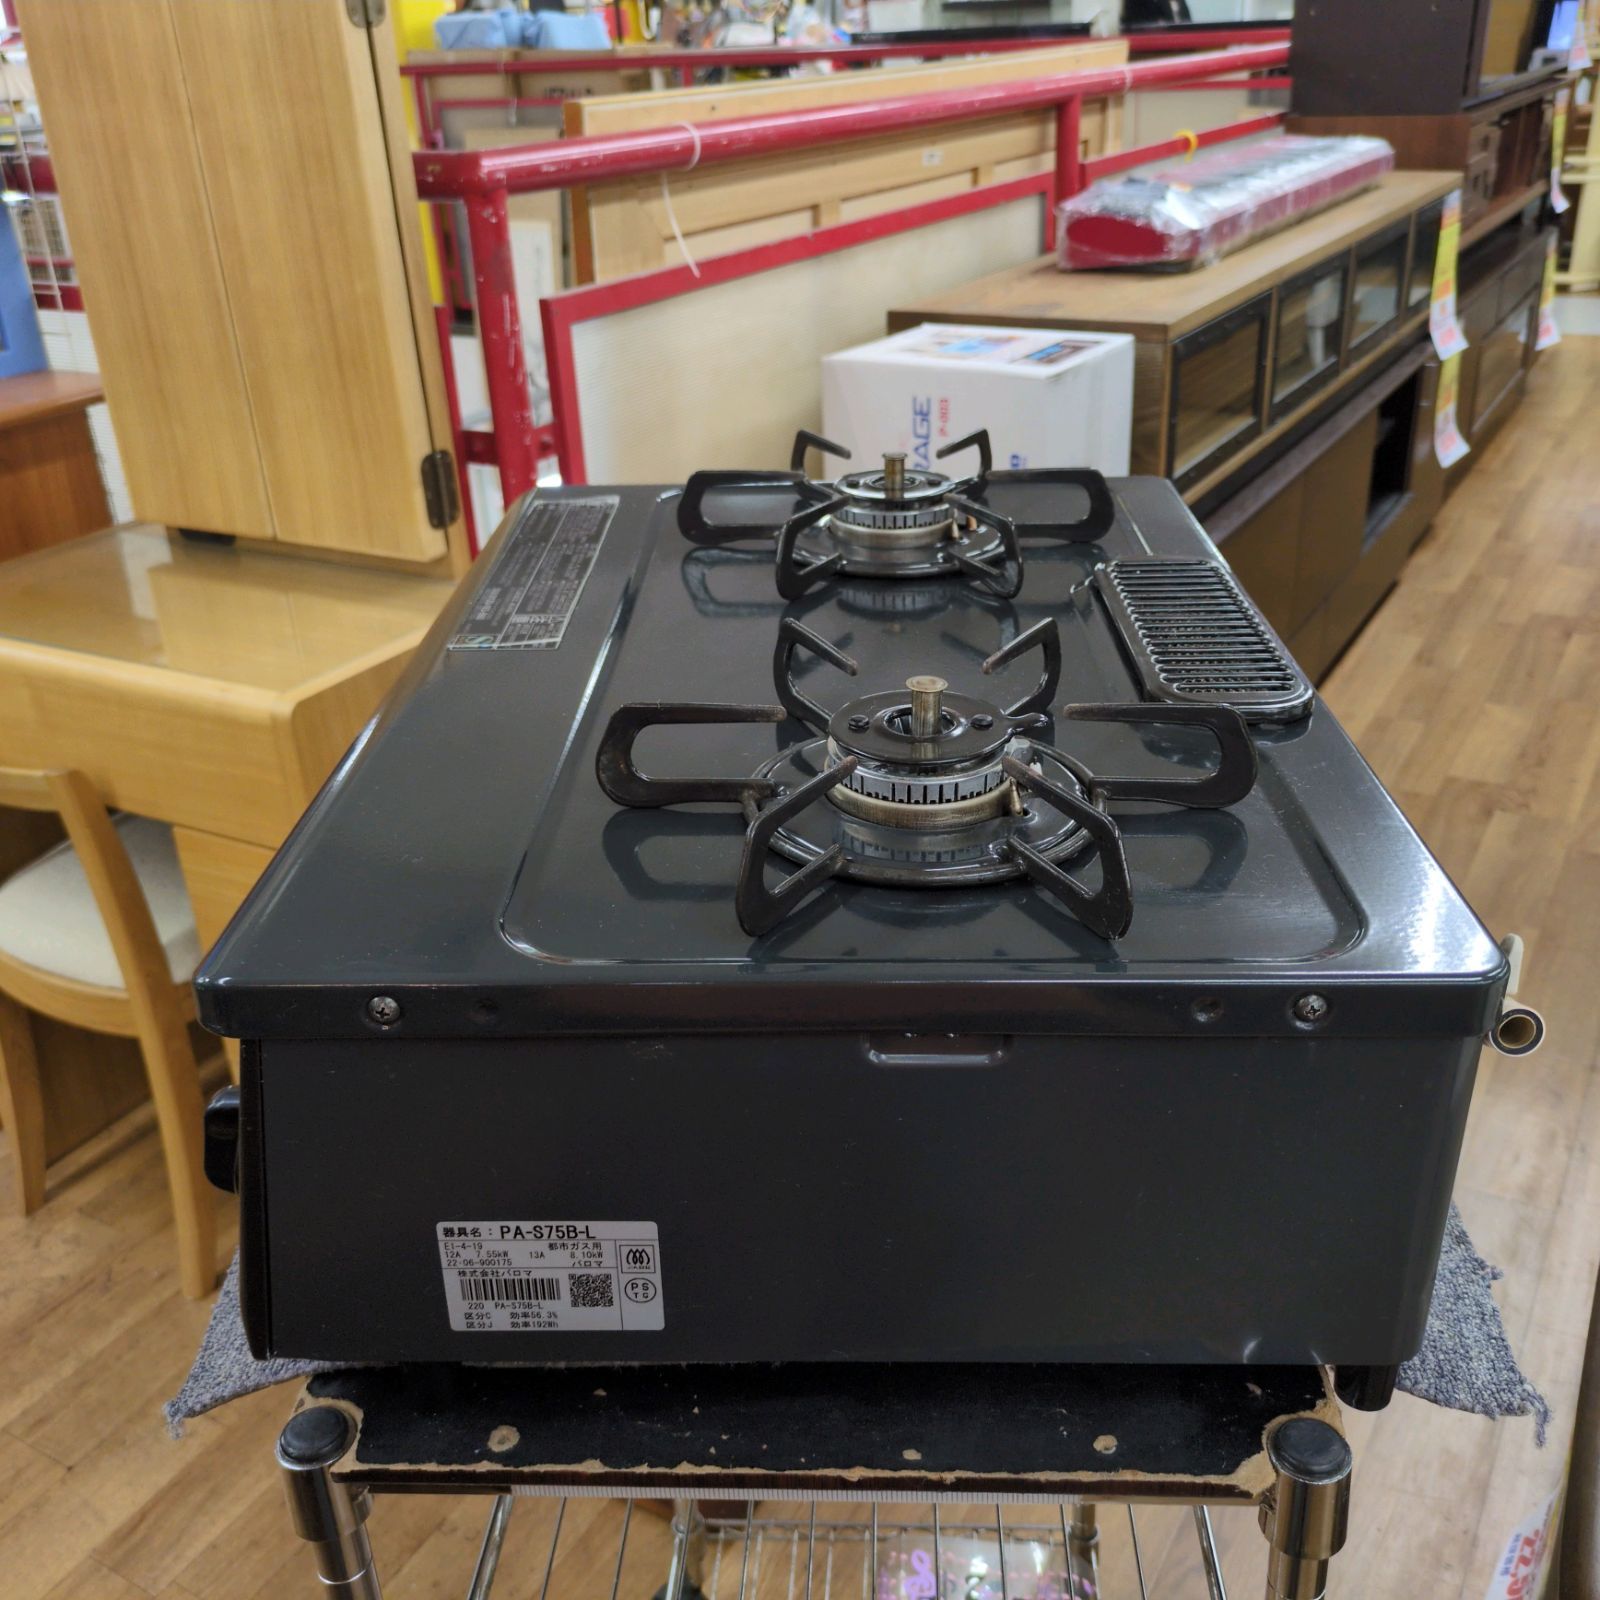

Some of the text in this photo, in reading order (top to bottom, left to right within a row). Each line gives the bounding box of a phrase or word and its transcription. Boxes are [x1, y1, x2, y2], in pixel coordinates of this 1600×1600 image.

[500, 1225, 597, 1239] PA-S75B-L
[548, 1242, 602, 1251] 都市ガス用
[529, 1251, 545, 1259] 13A
[457, 1269, 532, 1278] 株式会社パロマ
[468, 1302, 544, 1310] 220 PA-S75B-L
